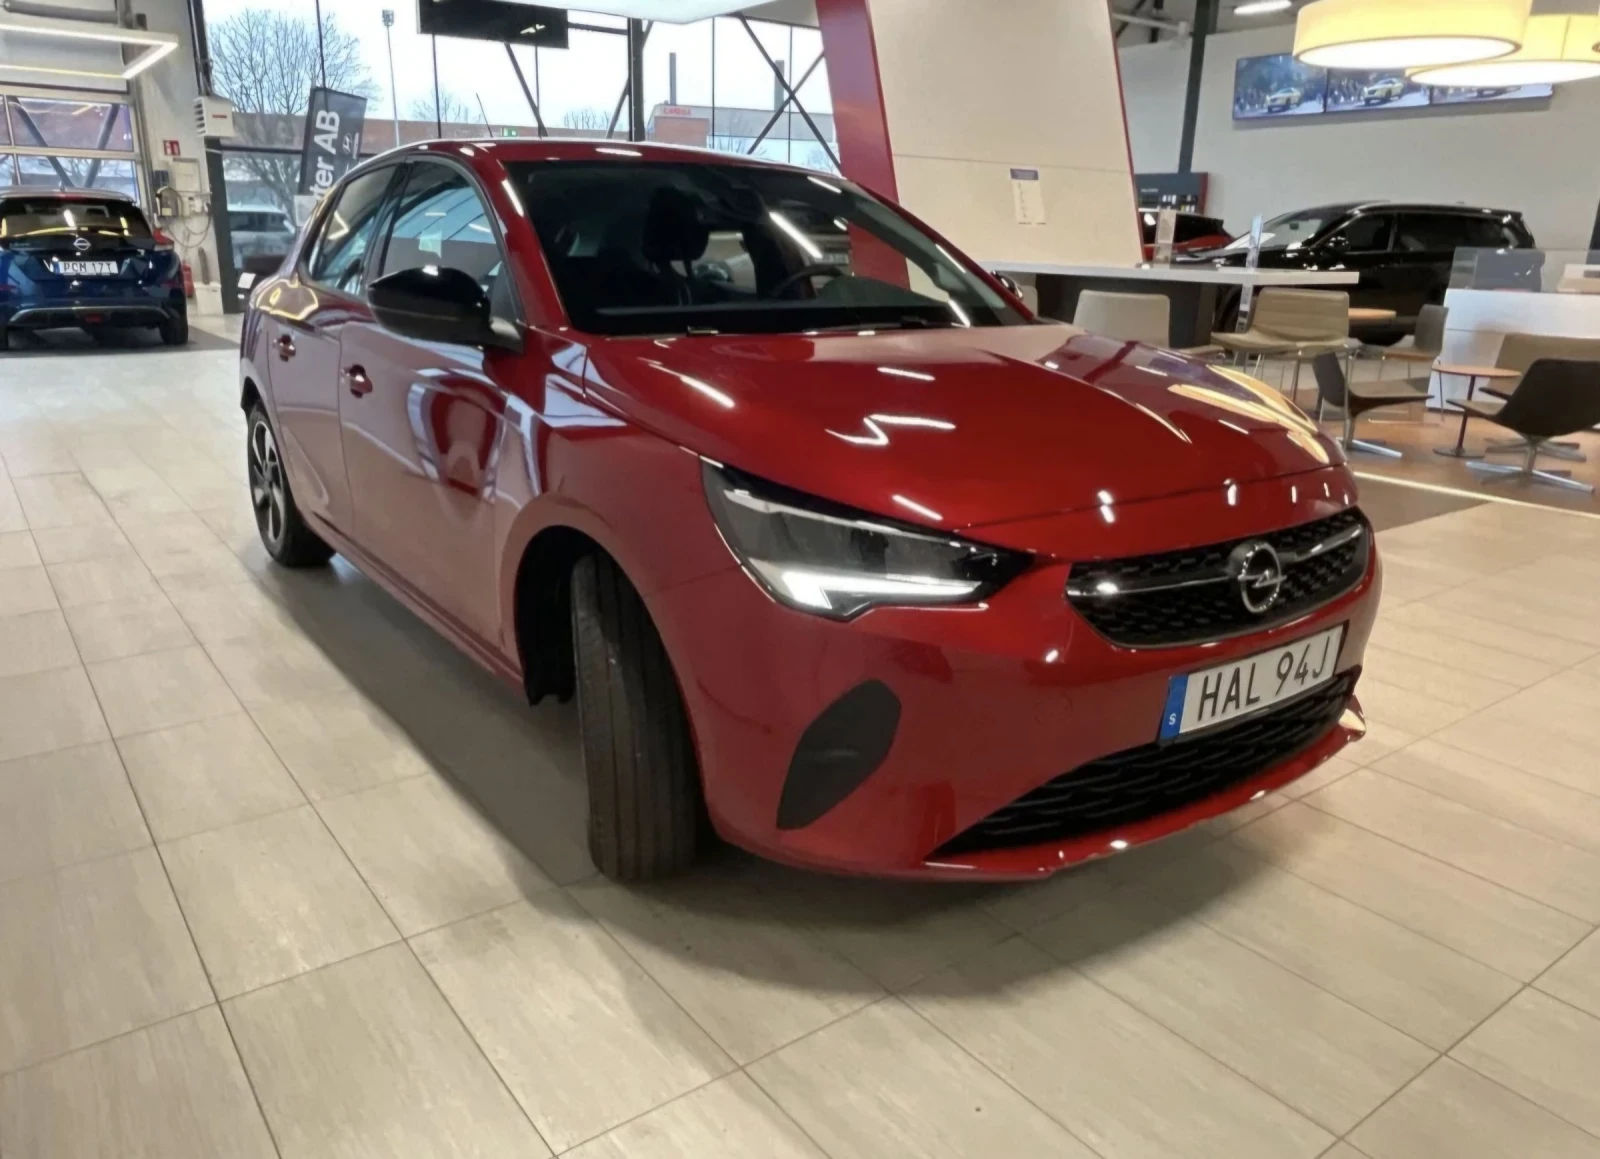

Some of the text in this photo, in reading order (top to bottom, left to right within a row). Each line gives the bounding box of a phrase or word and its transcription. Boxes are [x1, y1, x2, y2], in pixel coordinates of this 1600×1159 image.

[309, 109, 340, 201] ter AB
[1168, 713, 1177, 725] S
[1198, 636, 1330, 721] HAL 94J
